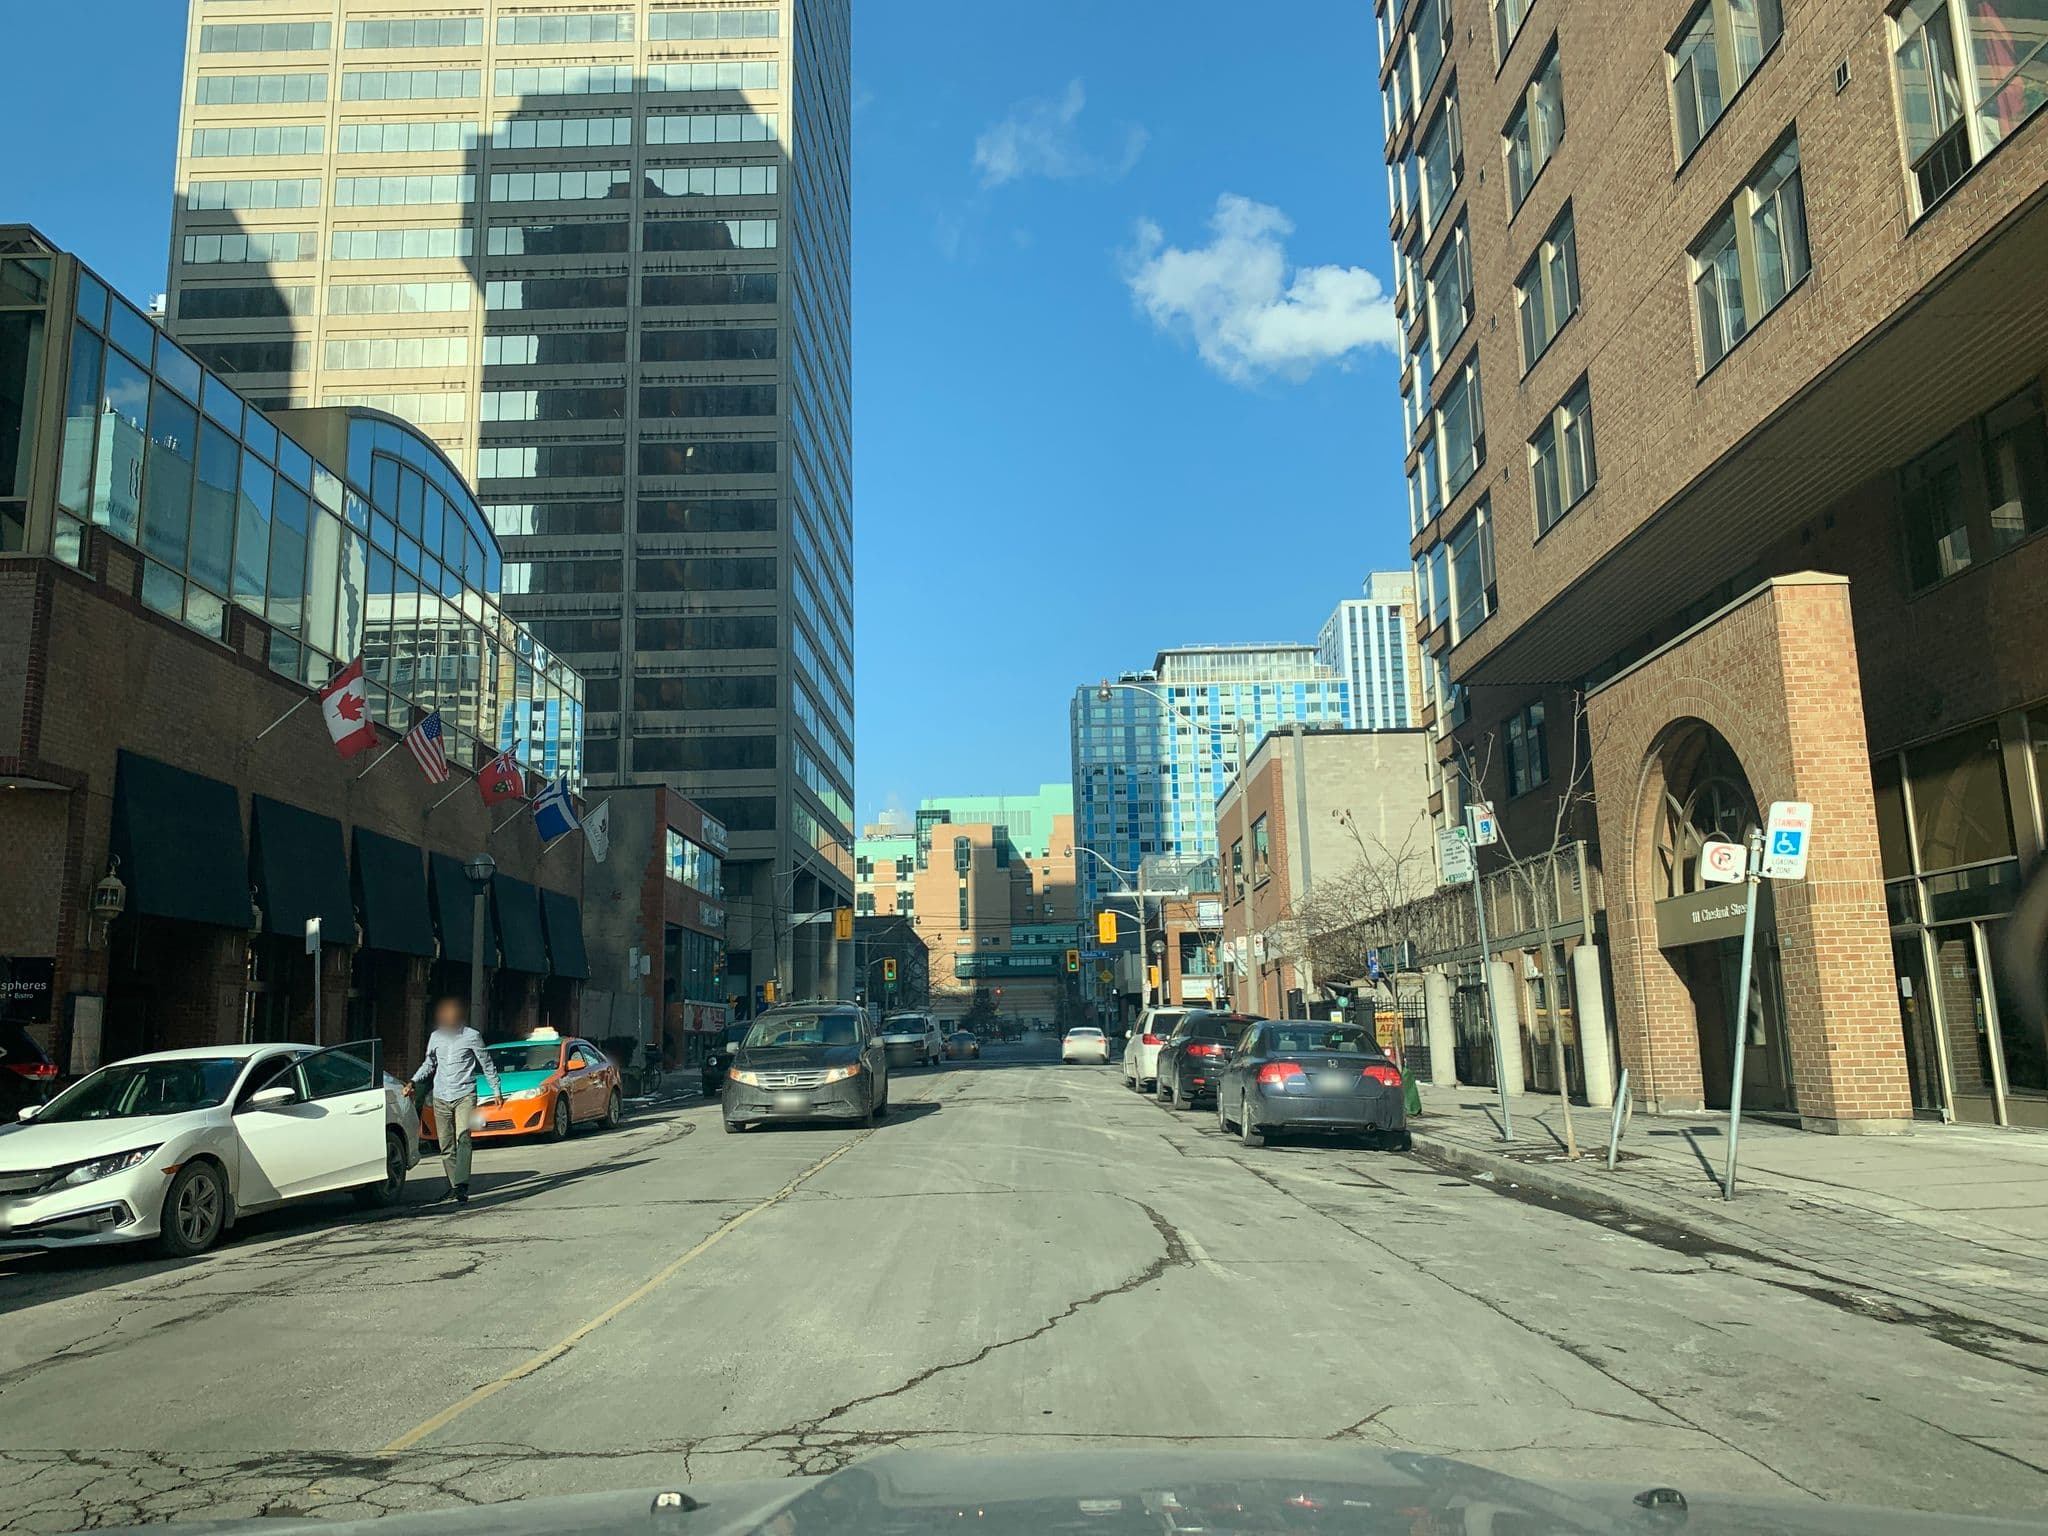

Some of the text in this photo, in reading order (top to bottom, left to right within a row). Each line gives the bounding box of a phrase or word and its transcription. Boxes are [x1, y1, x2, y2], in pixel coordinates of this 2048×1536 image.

[1774, 818, 1806, 828] STANDING
[1771, 858, 1799, 866] LOADING
[1701, 906, 1730, 921] Chestnut
[1730, 903, 1748, 916] Stree
